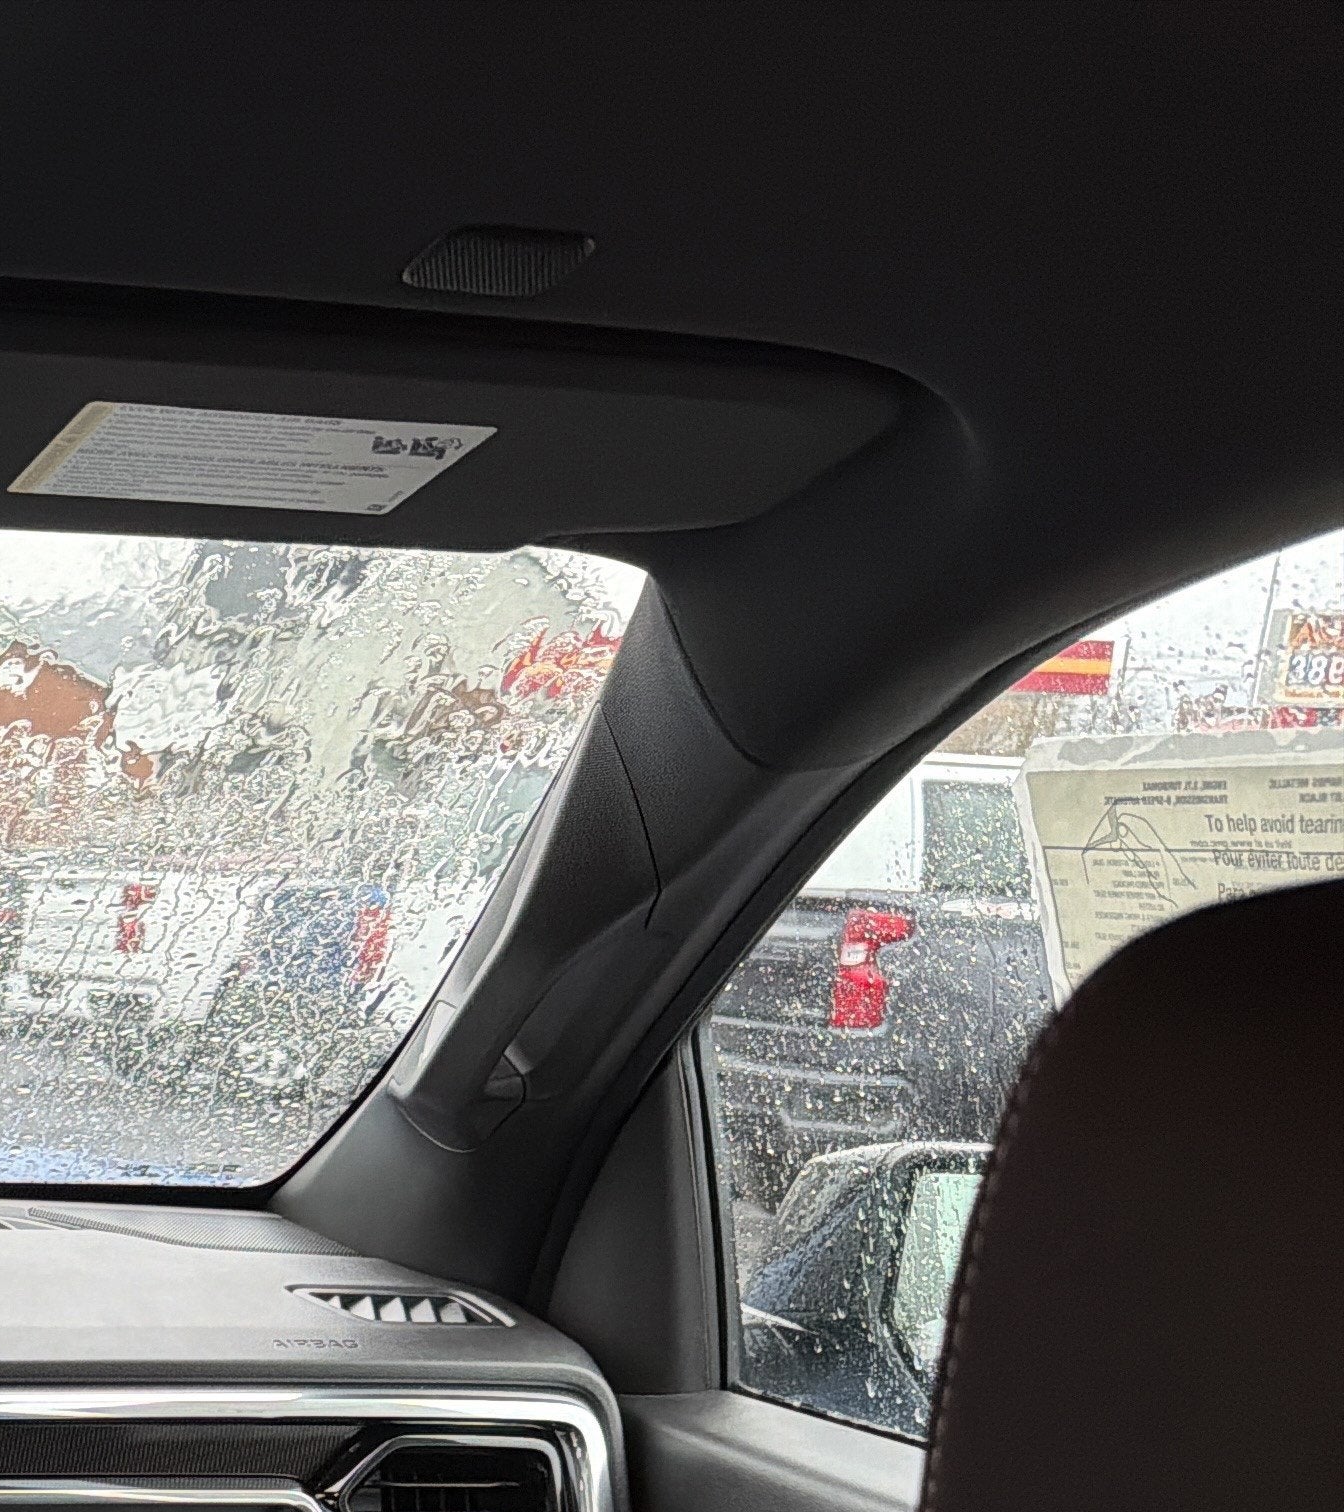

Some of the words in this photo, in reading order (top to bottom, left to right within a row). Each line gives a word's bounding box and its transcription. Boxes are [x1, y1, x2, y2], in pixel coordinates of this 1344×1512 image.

[1205, 815, 1223, 832] To
[1227, 813, 1257, 835] help
[1261, 815, 1294, 833] avoid
[1214, 851, 1244, 868] Pour
